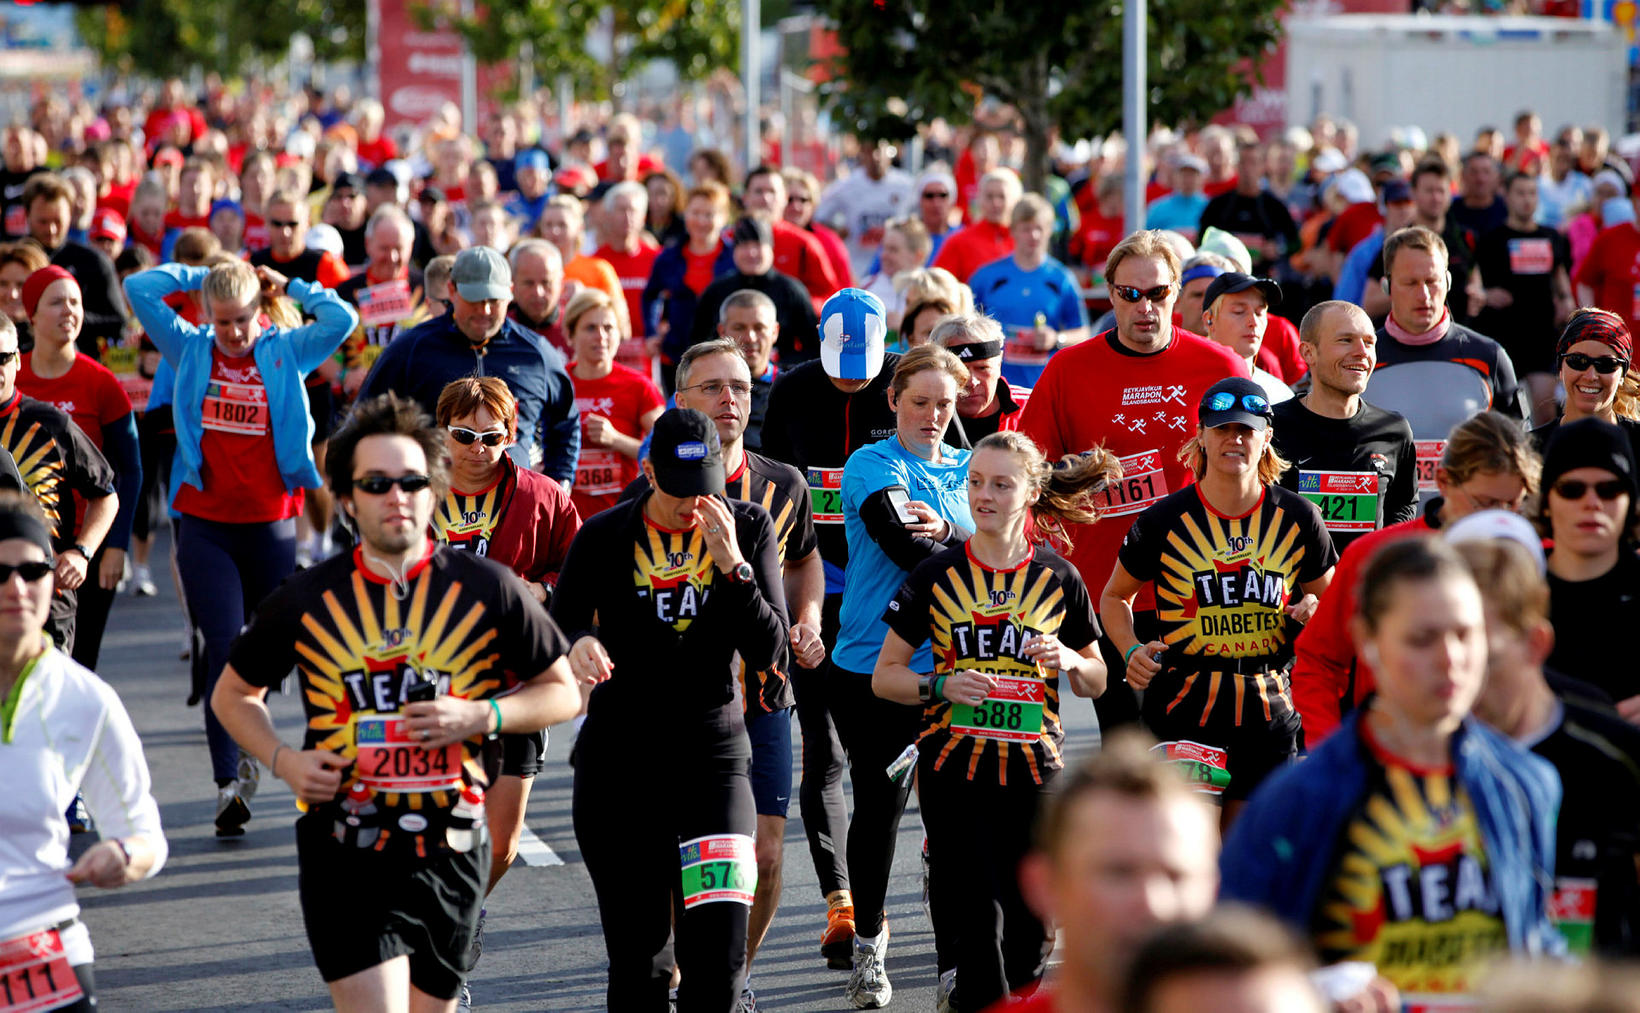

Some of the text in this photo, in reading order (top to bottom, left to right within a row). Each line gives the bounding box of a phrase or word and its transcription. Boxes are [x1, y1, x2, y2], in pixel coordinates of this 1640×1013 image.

[1123, 391, 1162, 400] MARAÞON
[1124, 385, 1163, 393] REYKJAVÍKUR
[213, 401, 259, 424] 1802
[1102, 475, 1155, 506] 1161
[463, 511, 487, 524] 10th
[1319, 496, 1358, 520] 421
[1229, 536, 1254, 552] 10th
[668, 551, 694, 567] 10th
[990, 590, 1016, 606] 10th
[1197, 570, 1283, 607] TEAM
[1200, 612, 1279, 637] DIABETES
[972, 701, 1022, 730] 588
[373, 746, 449, 777] 2034
